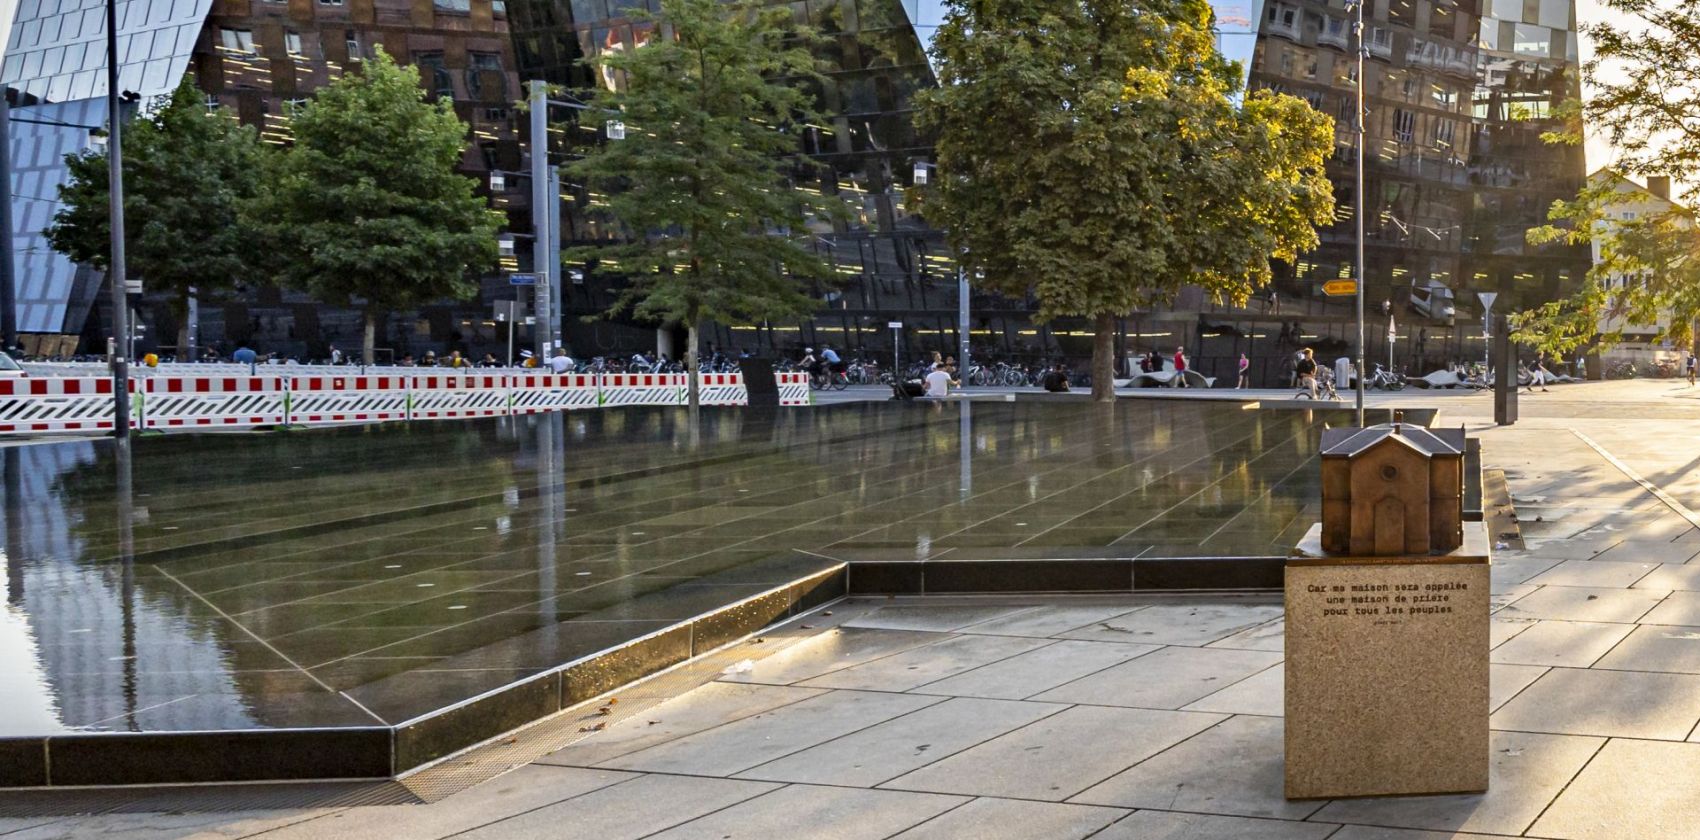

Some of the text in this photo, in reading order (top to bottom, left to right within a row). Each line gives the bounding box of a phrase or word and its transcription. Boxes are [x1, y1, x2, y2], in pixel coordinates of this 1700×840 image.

[1307, 584, 1328, 593] Car
[1351, 583, 1389, 592] maison
[1395, 583, 1419, 591] sera
[1326, 596, 1346, 604] une
[1351, 594, 1389, 604] maison
[1394, 594, 1407, 603] de
[1323, 605, 1453, 617] pour tous les peuples
